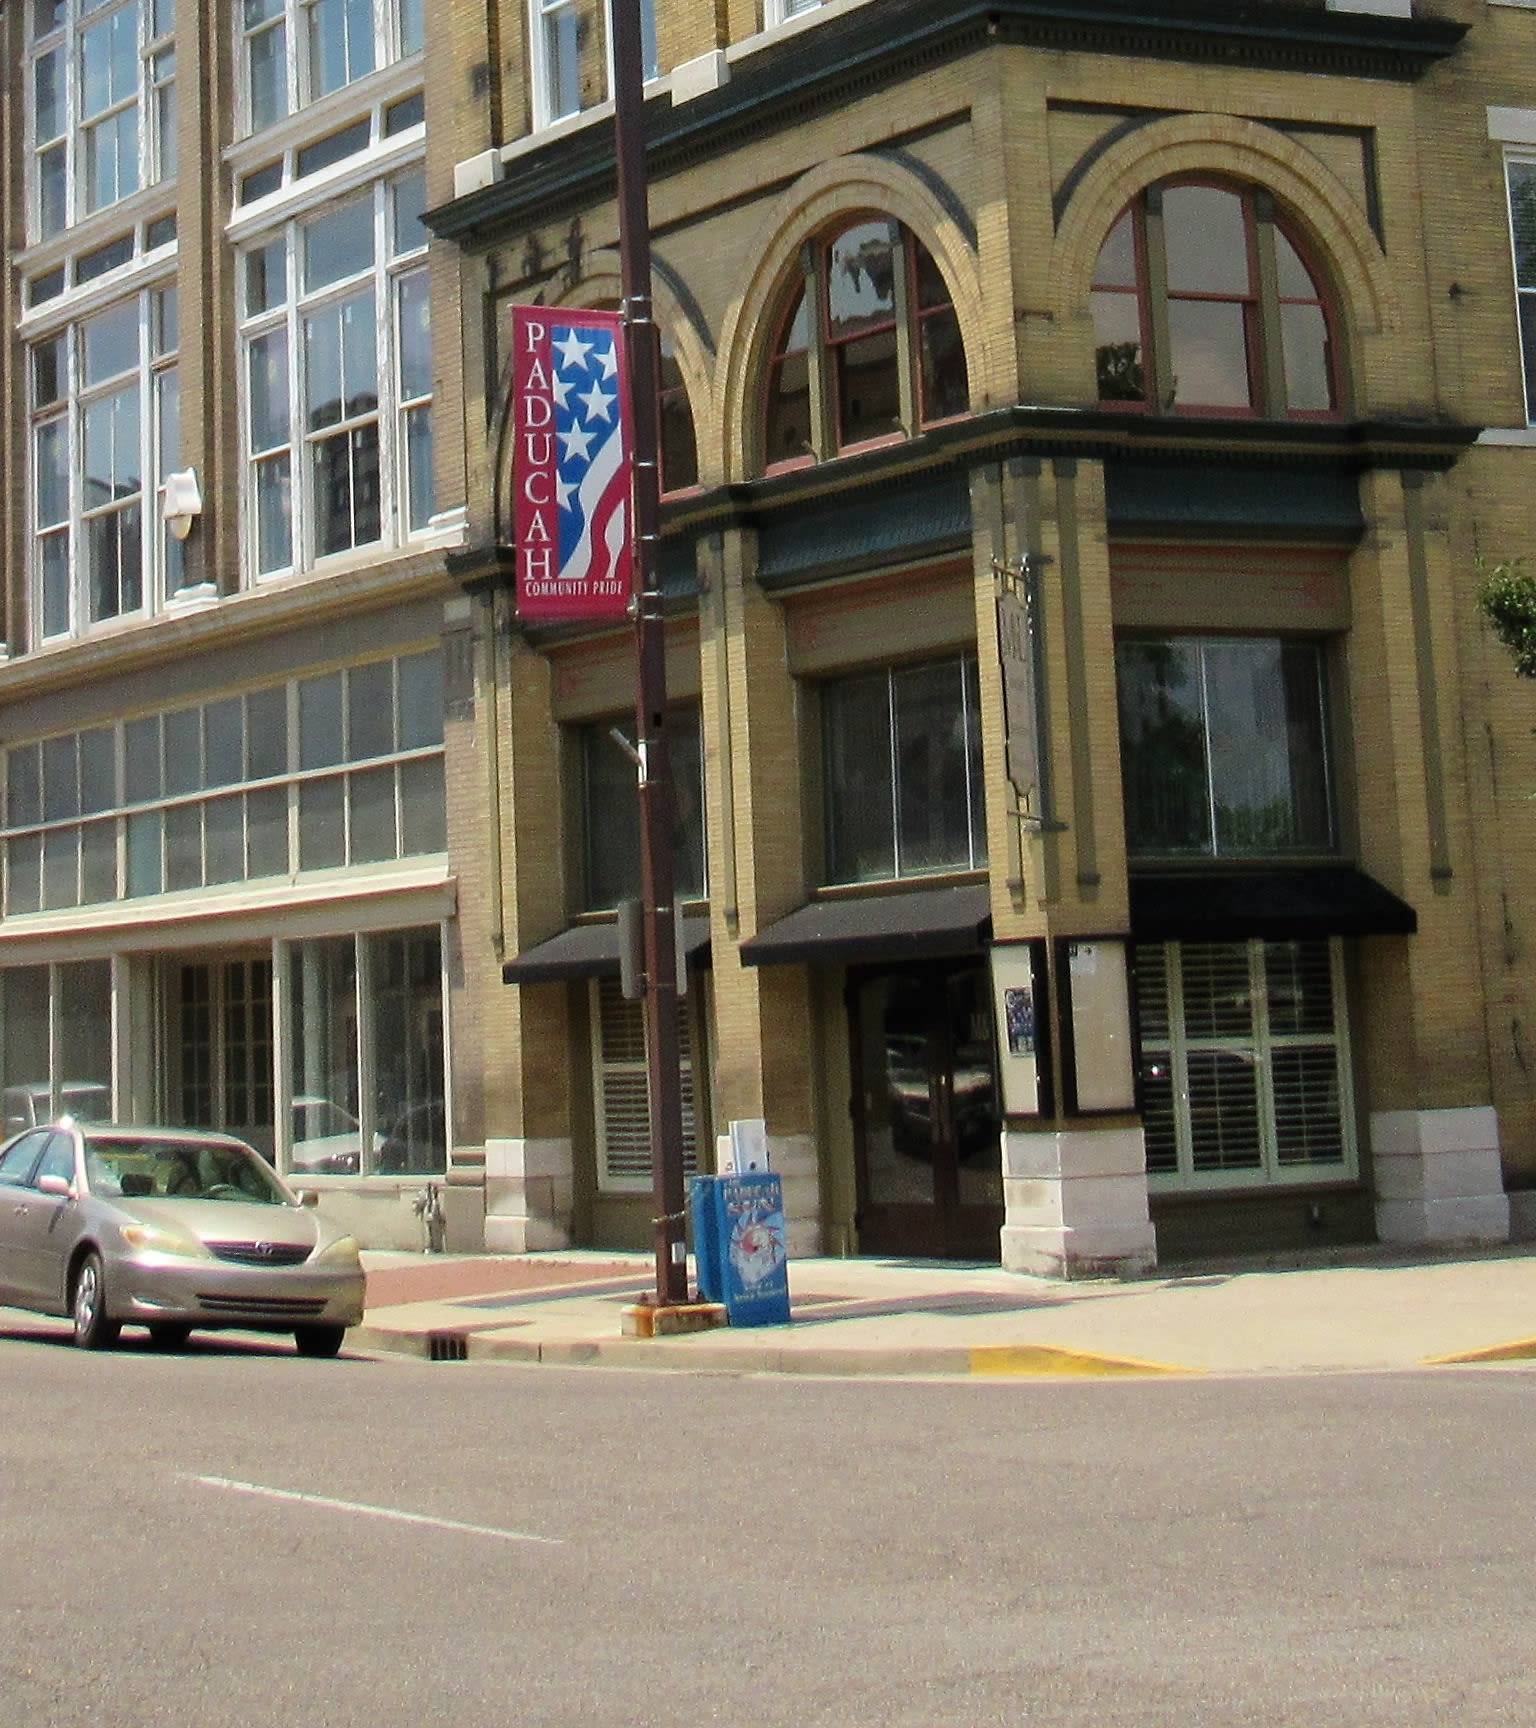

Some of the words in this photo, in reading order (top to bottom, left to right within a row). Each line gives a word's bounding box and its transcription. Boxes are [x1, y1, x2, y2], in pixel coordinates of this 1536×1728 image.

[524, 321, 553, 580] PADUCAH
[525, 580, 588, 597] COMMUNITY
[592, 579, 623, 595] PRIDE
